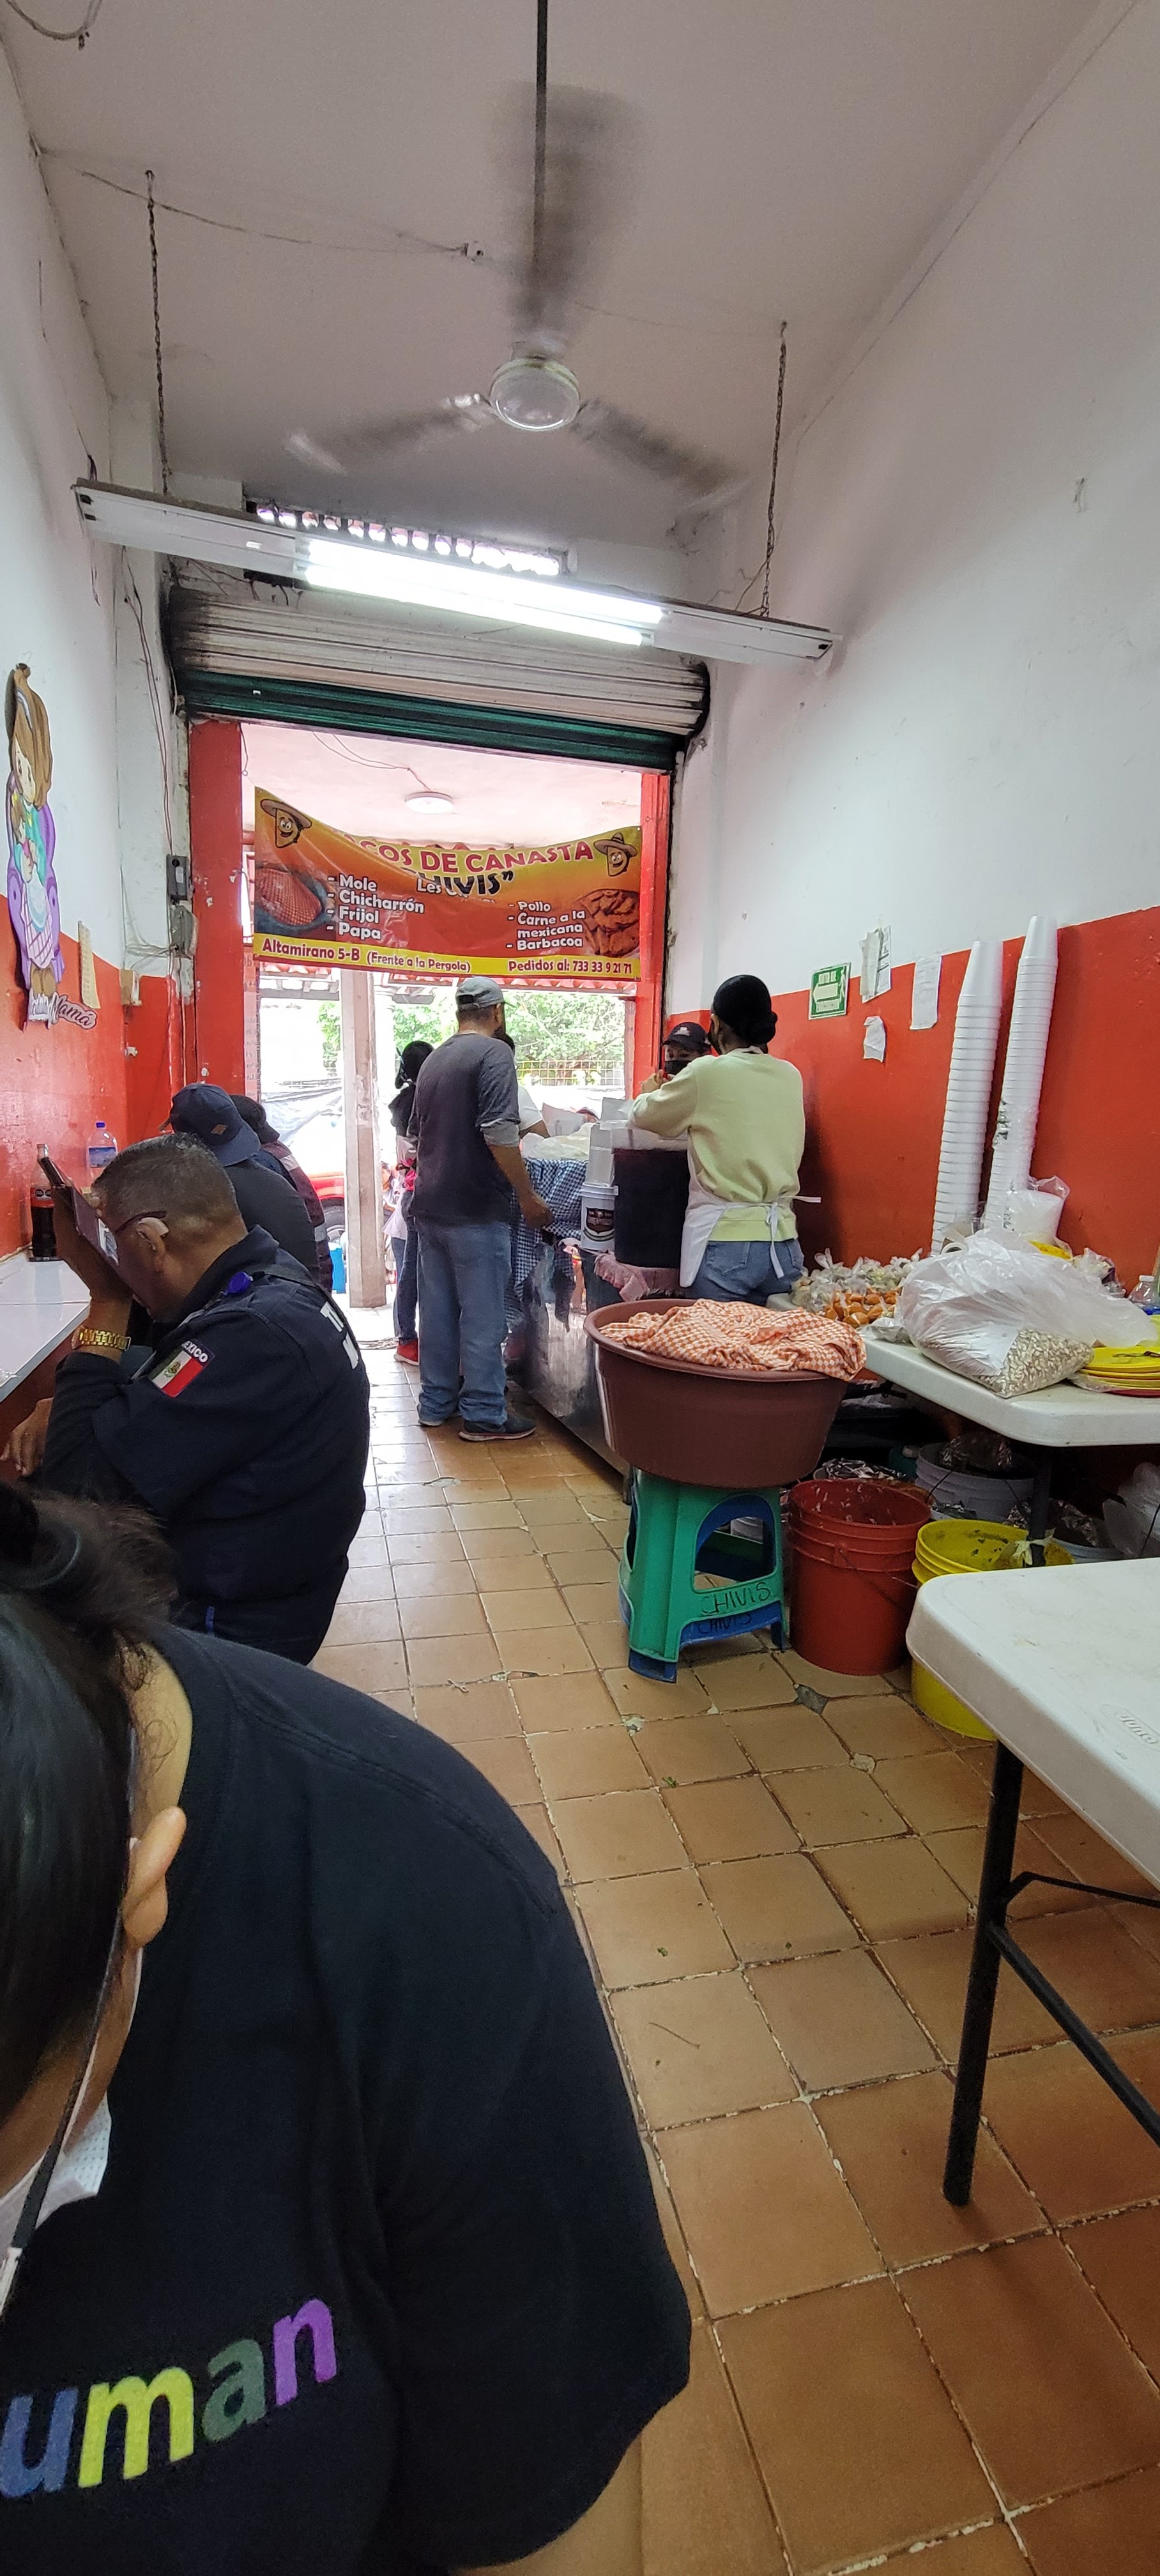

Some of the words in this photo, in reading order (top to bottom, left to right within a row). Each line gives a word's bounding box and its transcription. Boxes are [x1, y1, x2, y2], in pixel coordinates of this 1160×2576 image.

[344, 834, 413, 866] COS
[420, 850, 459, 873] DE
[464, 841, 594, 873] CANASTA
[339, 874, 377, 891] Mole
[416, 878, 442, 894] Les
[339, 889, 424, 913] Chicharrón
[518, 901, 551, 912] Pollo
[339, 906, 379, 923] Frijol
[517, 912, 556, 926] Carne
[560, 914, 569, 923] a
[572, 910, 586, 920] la
[339, 922, 381, 940] Papa
[517, 923, 583, 939] mexicana
[517, 937, 583, 951] Barbacoa
[262, 938, 335, 960] Altamirano
[338, 948, 360, 961] 5-B
[367, 951, 404, 967] (Frente
[406, 959, 413, 967] a
[416, 958, 425, 968] la
[429, 960, 471, 973] Pergola)
[508, 960, 554, 972] Pedidos
[557, 958, 570, 972] al:
[573, 960, 589, 972] 733
[591, 961, 603, 972] 33
[606, 962, 611, 973] 9
[613, 962, 621, 974] 21
[623, 963, 632, 974] 71
[51, 994, 93, 1026] Mamá
[182, 1340, 209, 1363] EXICO
[702, 1581, 771, 1614] CHIVIS
